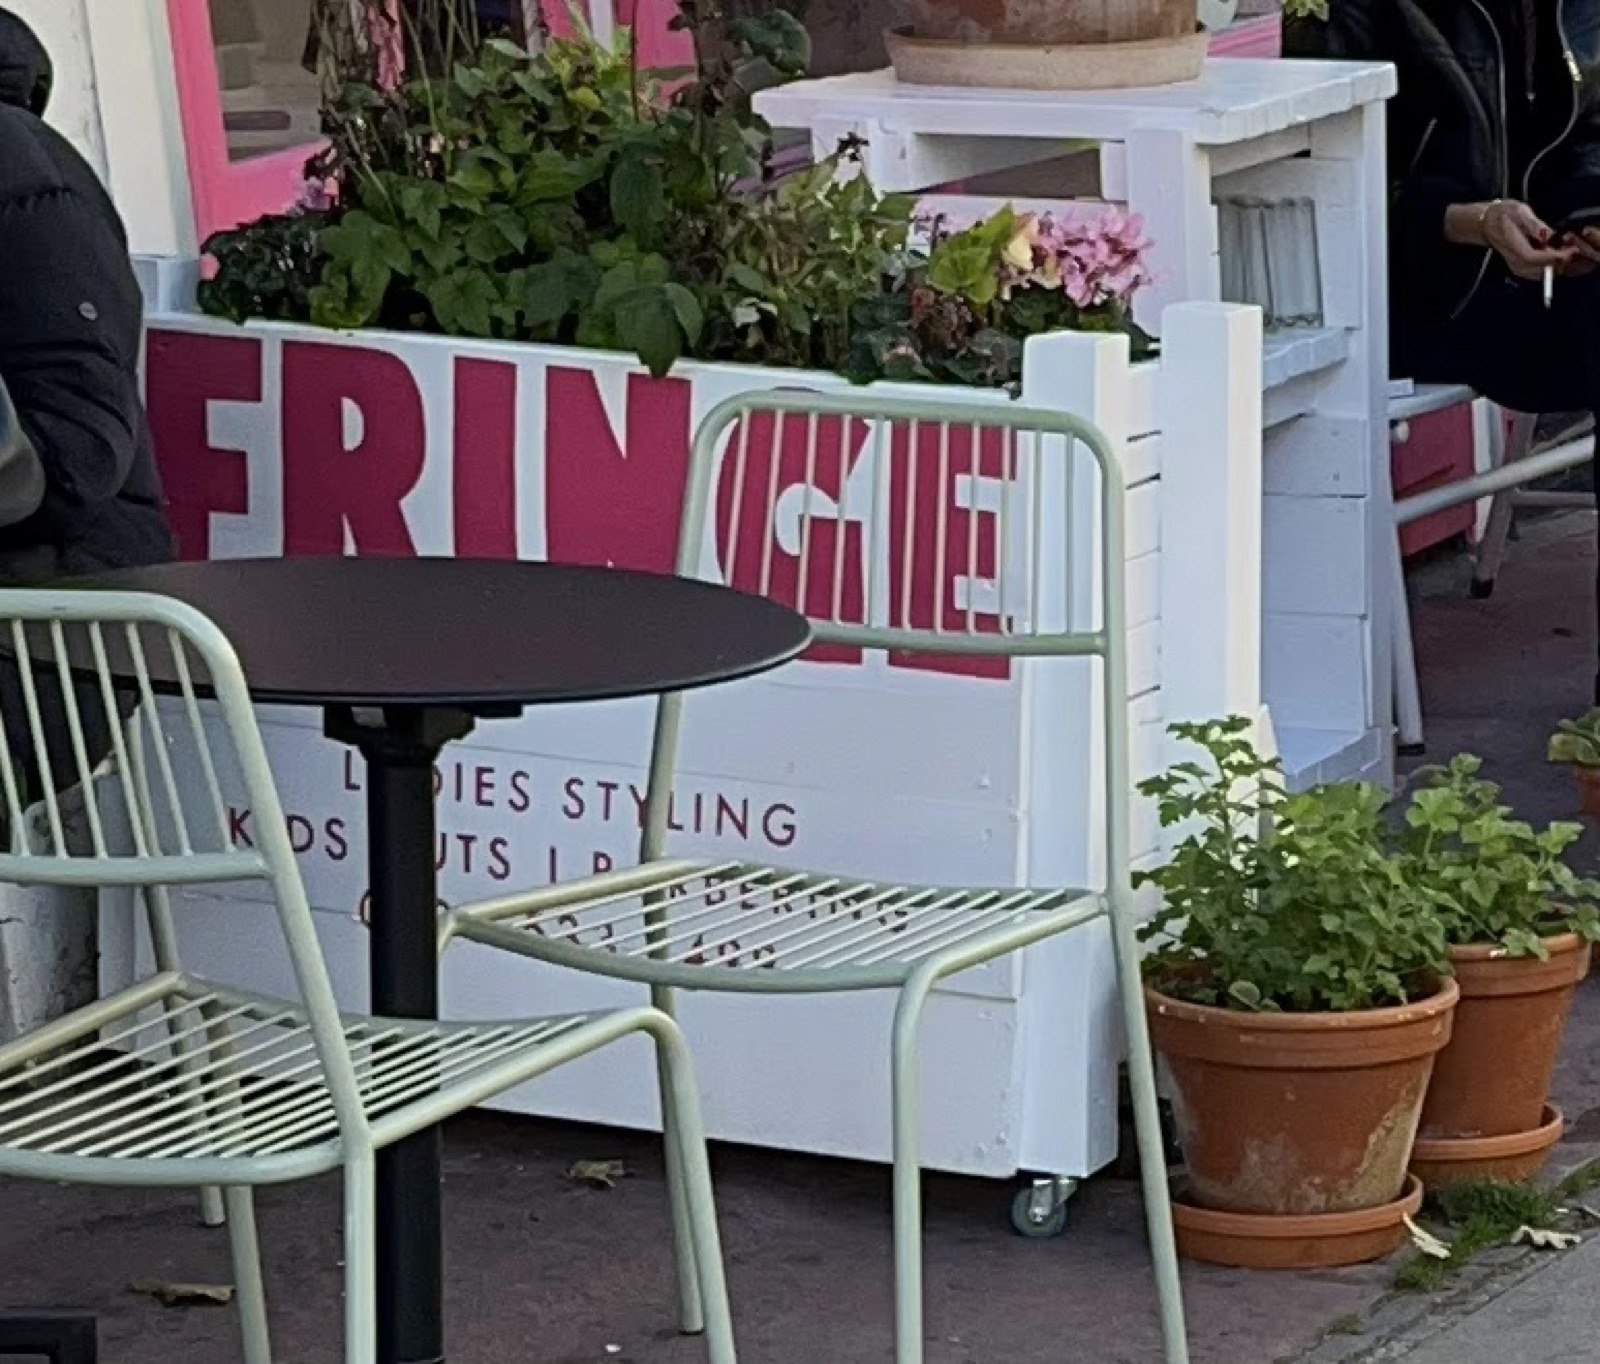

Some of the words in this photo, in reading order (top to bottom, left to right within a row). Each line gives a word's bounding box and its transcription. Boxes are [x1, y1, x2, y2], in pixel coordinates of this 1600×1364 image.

[147, 328, 1016, 680] FRINGE
[228, 806, 348, 861] KDS
[436, 832, 512, 880] UTS
[344, 749, 531, 812] LIES
[562, 777, 797, 847] STYLING
